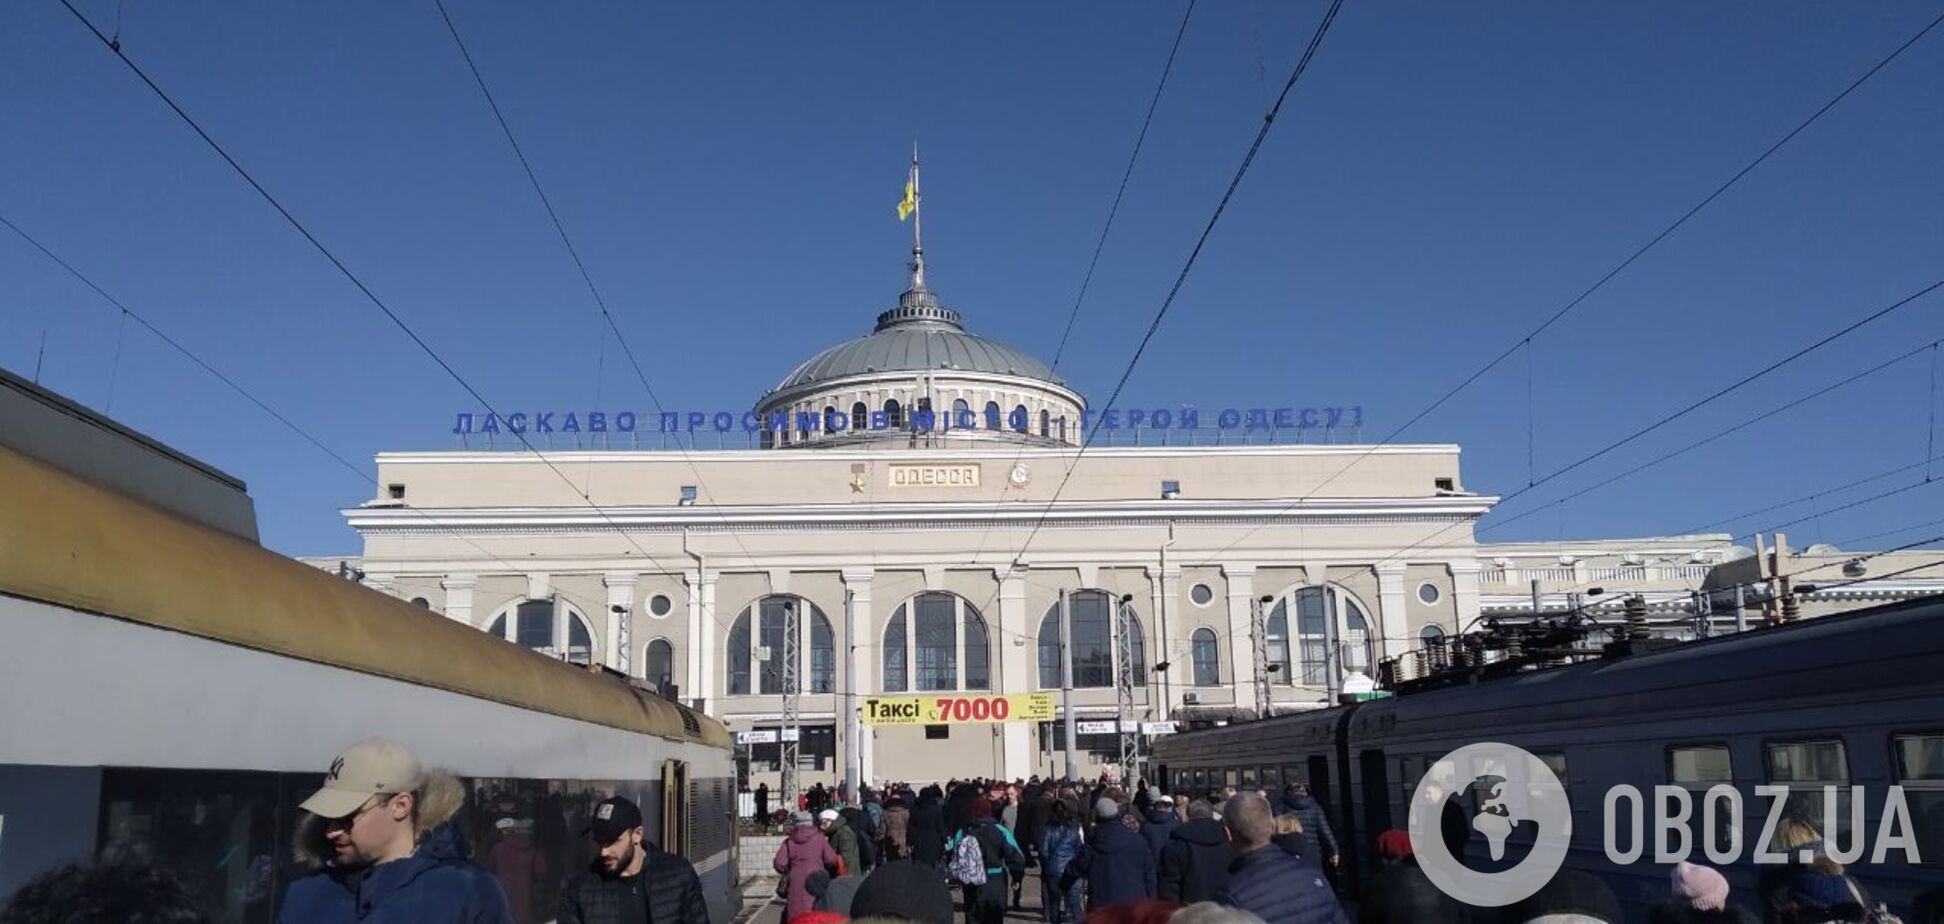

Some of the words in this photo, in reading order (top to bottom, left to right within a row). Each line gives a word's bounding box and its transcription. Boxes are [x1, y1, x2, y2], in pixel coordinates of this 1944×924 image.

[453, 411, 638, 434] ЛАСКАВО
[658, 411, 850, 434] ПРОСИМО
[872, 410, 891, 430] В
[894, 468, 974, 484] ОДЕССА
[867, 699, 919, 718] Таксі
[936, 698, 1009, 722] 7000
